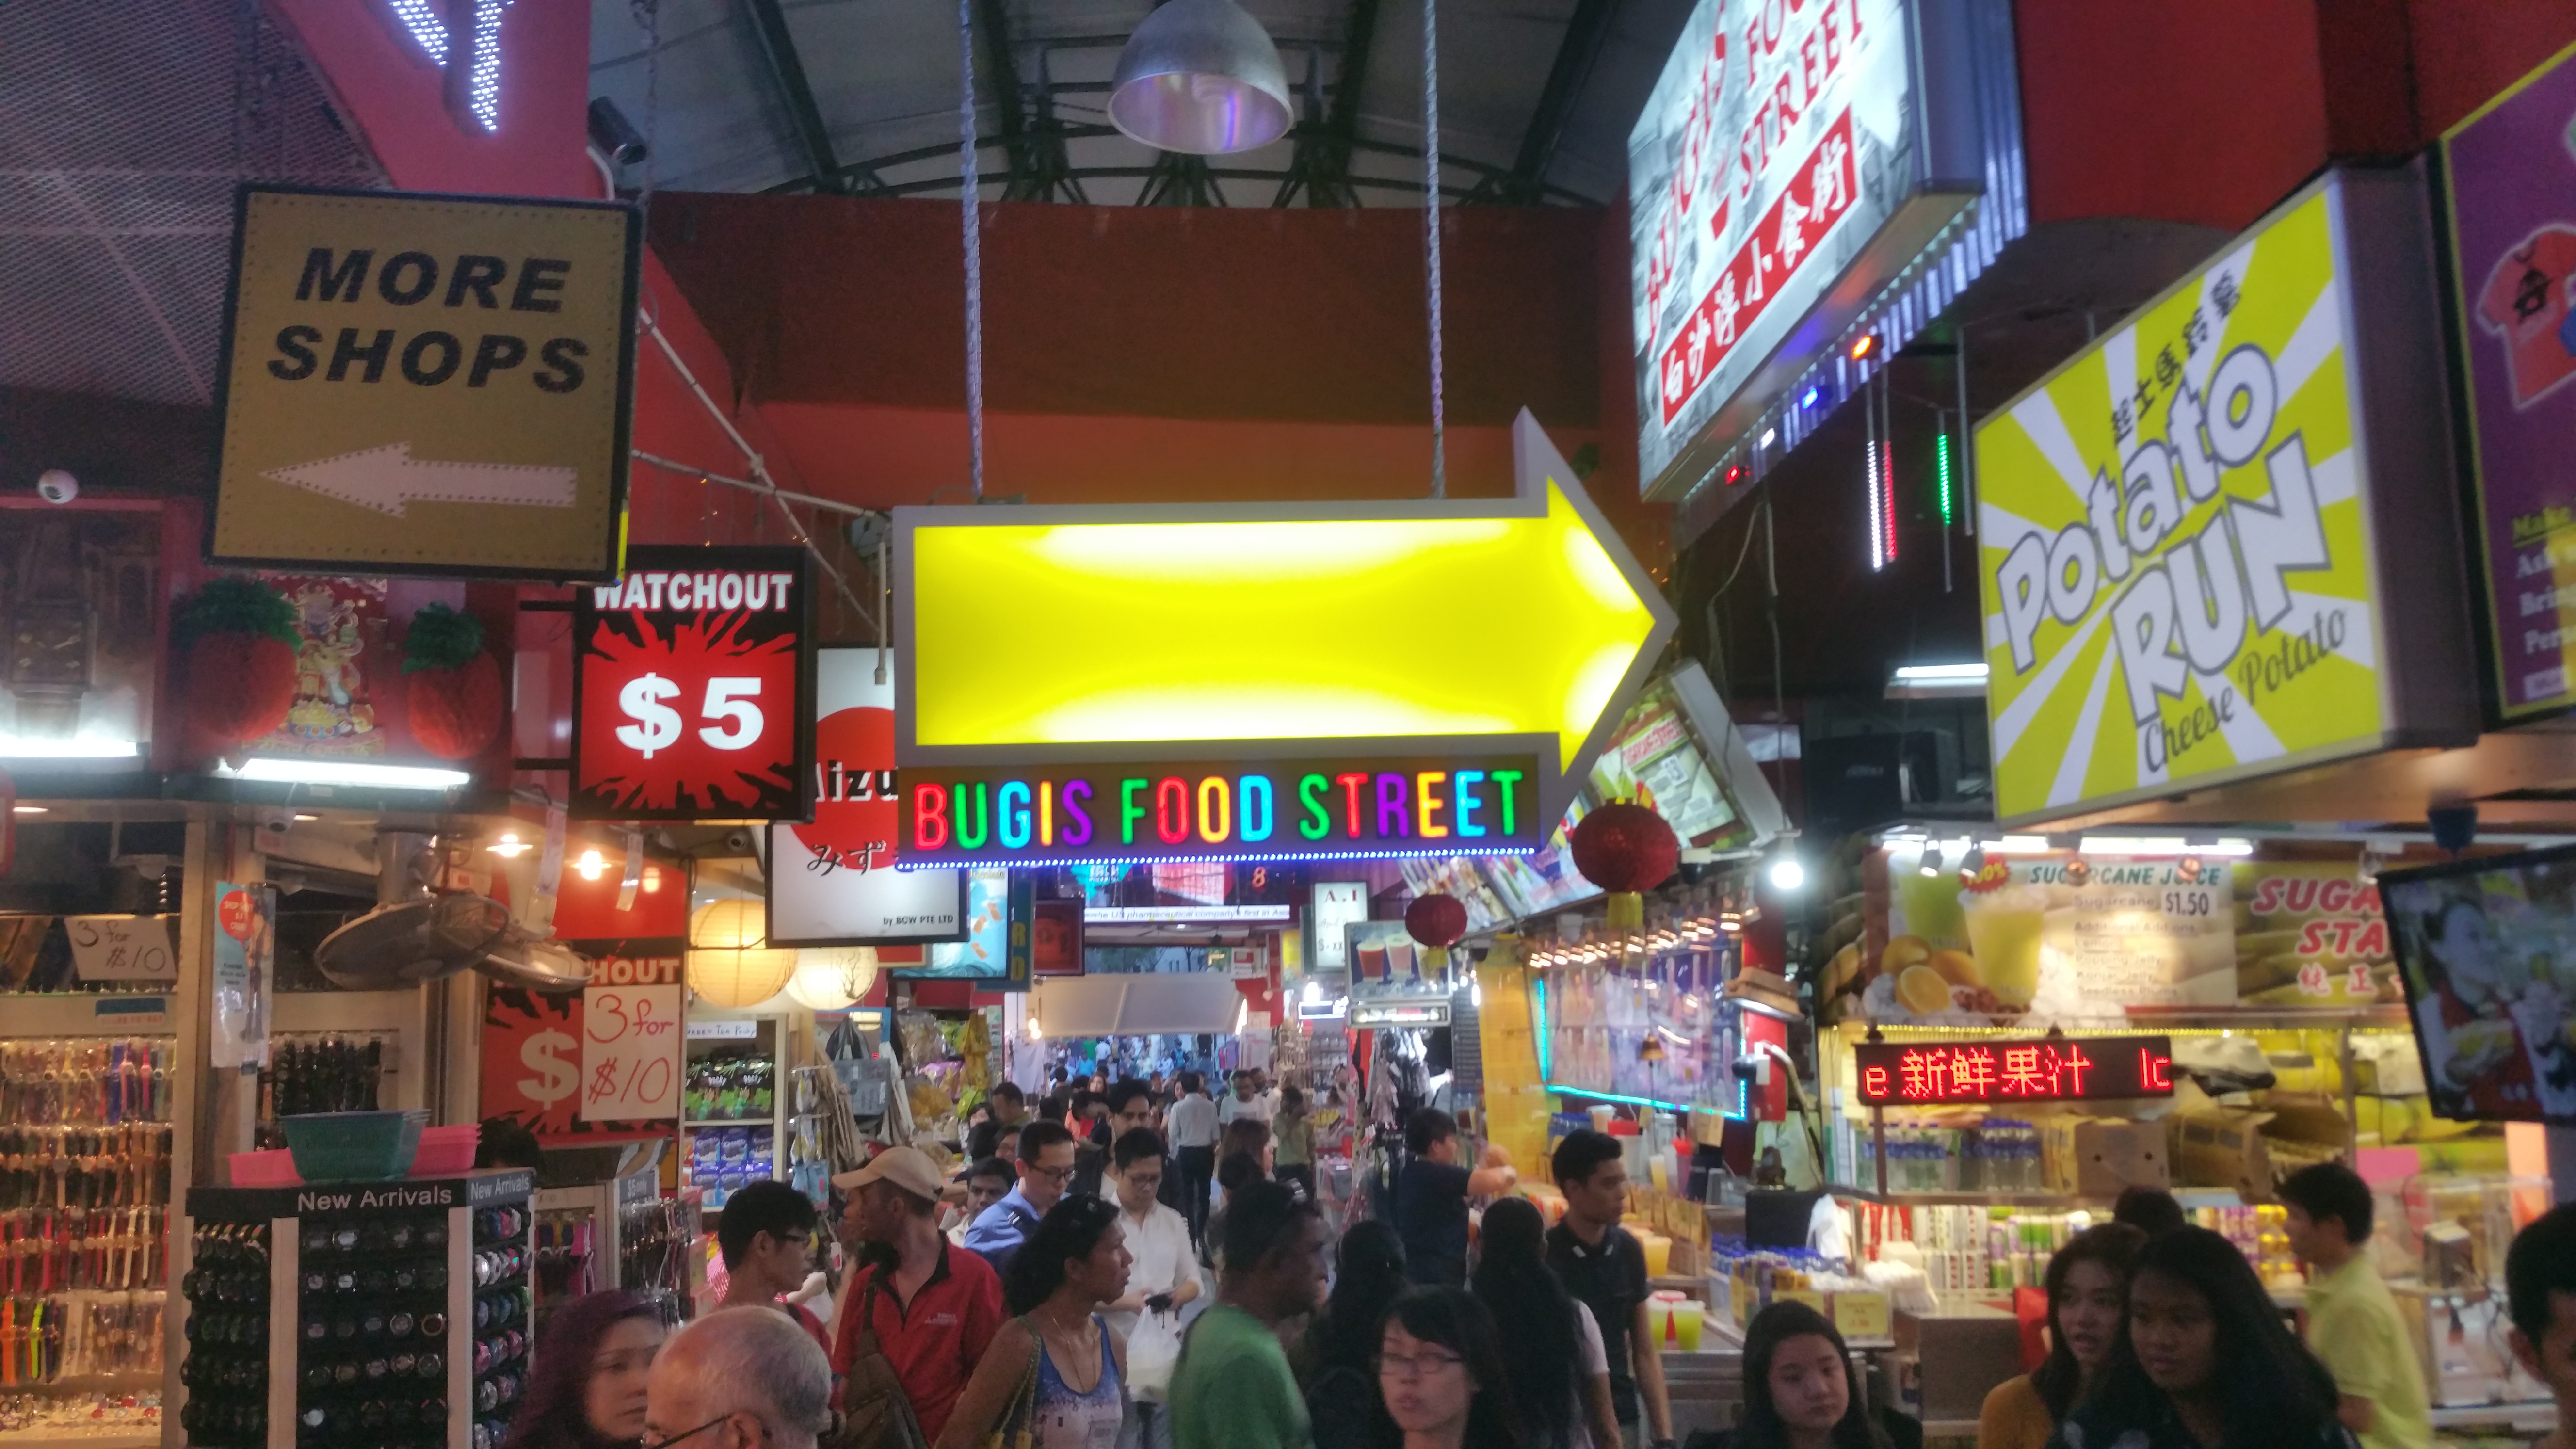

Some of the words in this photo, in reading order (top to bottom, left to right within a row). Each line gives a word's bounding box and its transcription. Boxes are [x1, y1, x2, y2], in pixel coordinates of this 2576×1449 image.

[294, 247, 572, 313] MORE
[1664, 132, 1848, 404] 白沙浮小食街
[267, 325, 590, 393] SHOPS
[594, 573, 792, 609] WATCHOUT
[2110, 429, 2333, 729] RUN
[2145, 682, 2235, 773] Cheese
[2238, 607, 2346, 706] Potato
[915, 779, 1093, 850] BUGIS
[1121, 775, 1273, 845] FOOD
[1299, 770, 1523, 840] STREET
[807, 840, 898, 876] みず
[1967, 862, 2006, 886] 00%
[2030, 866, 2154, 885] SUGRCANE
[2160, 866, 2221, 886] JCE
[883, 916, 893, 925] by
[920, 915, 935, 923] PTE
[938, 915, 953, 923] LTD
[2166, 892, 2209, 916] $1.50
[74, 920, 99, 948] 3
[105, 919, 131, 942] for
[106, 946, 166, 970] $10
[588, 994, 628, 1043] 3
[633, 999, 674, 1036] for
[588, 1057, 670, 1104] $10
[1865, 1066, 1889, 1096] e
[1901, 1043, 2093, 1098] 新鲜果汁
[297, 1191, 351, 1212] New
[359, 1185, 452, 1209] Arrivals
[470, 1180, 494, 1201] New
[495, 1173, 529, 1196] Arrivals
